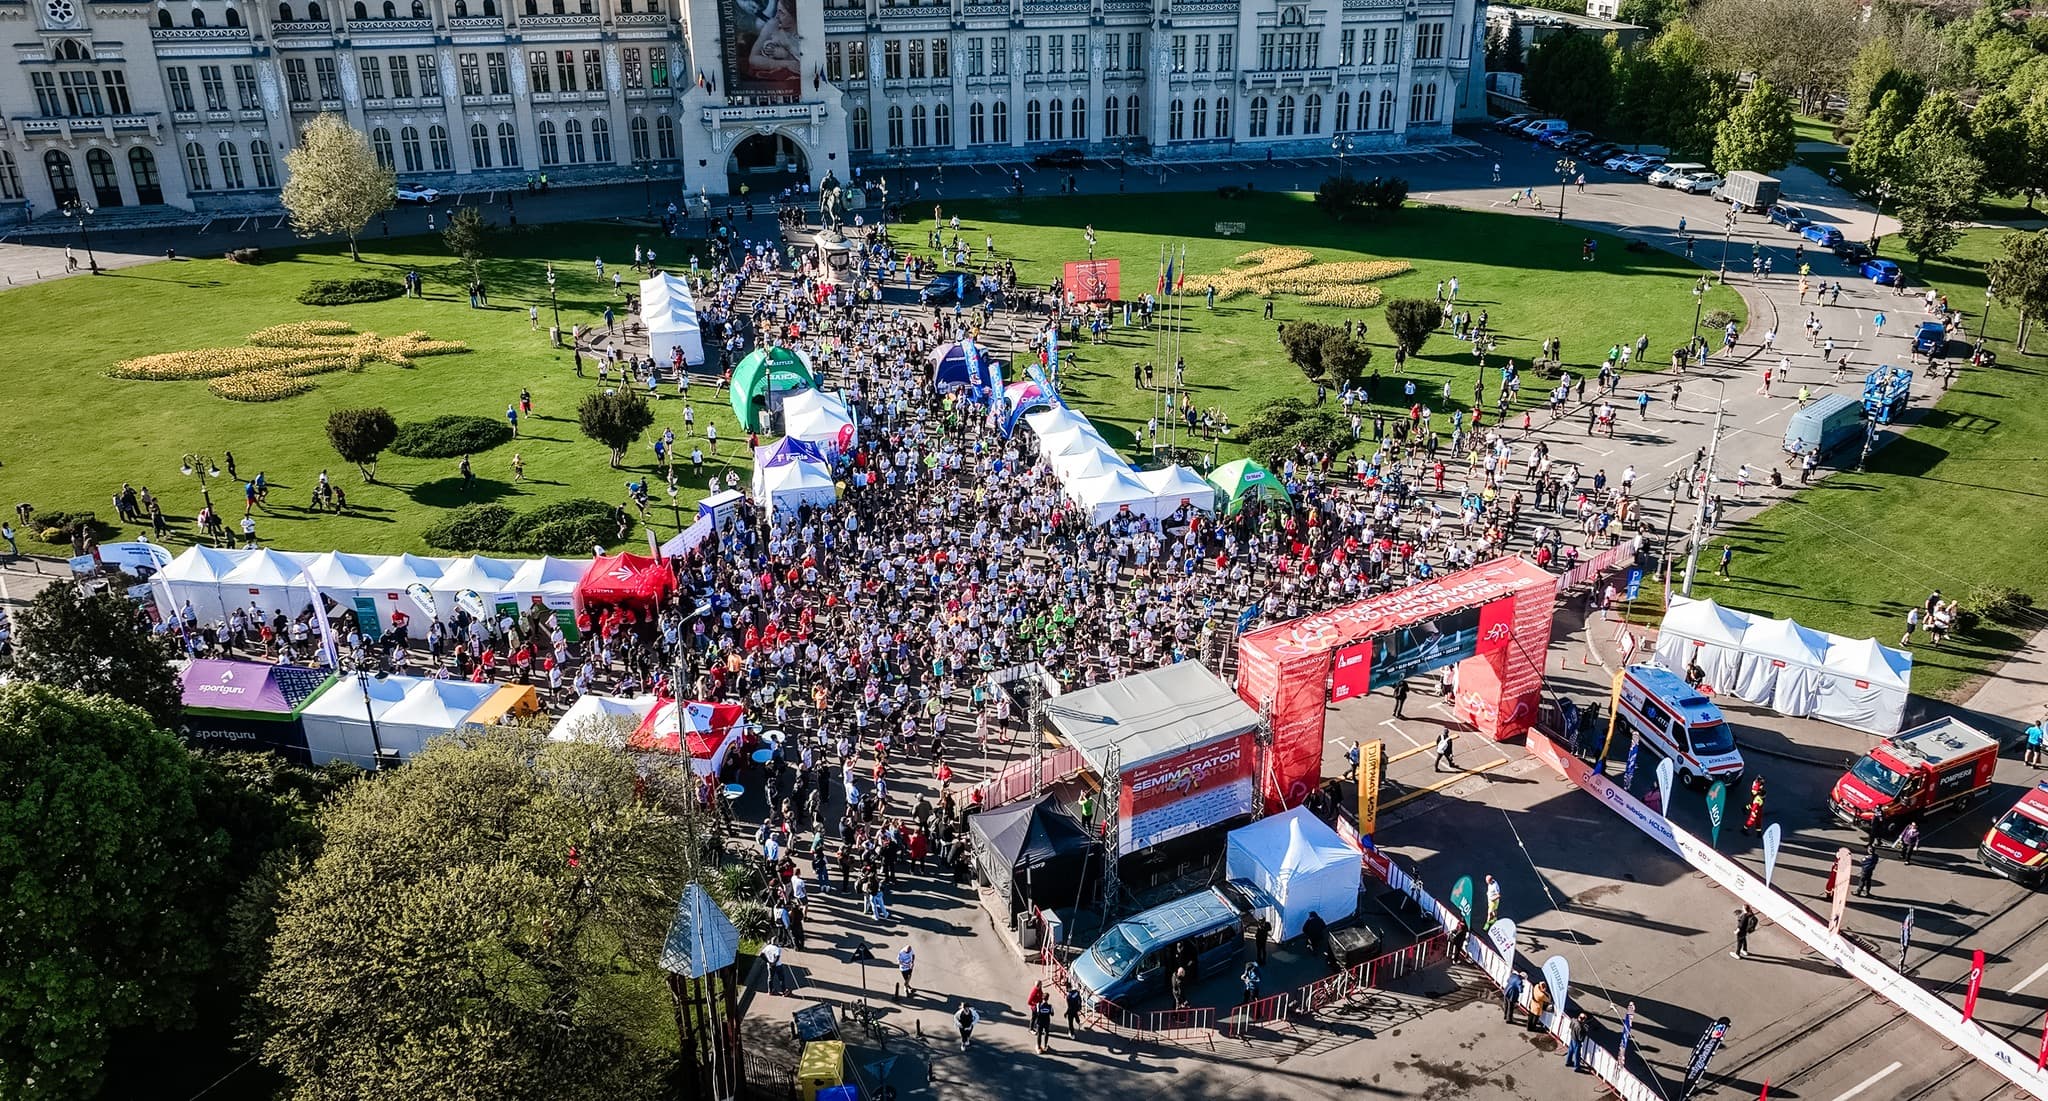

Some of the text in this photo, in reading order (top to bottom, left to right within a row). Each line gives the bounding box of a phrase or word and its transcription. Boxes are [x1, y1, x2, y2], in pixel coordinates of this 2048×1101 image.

[1632, 570, 1640, 581] P
[1630, 585, 1637, 596] P
[198, 683, 246, 695] sportguru
[195, 729, 257, 741] sportguru
[1132, 749, 1241, 793] SEMIMARATON
[1648, 819, 1674, 840] HCLTech
